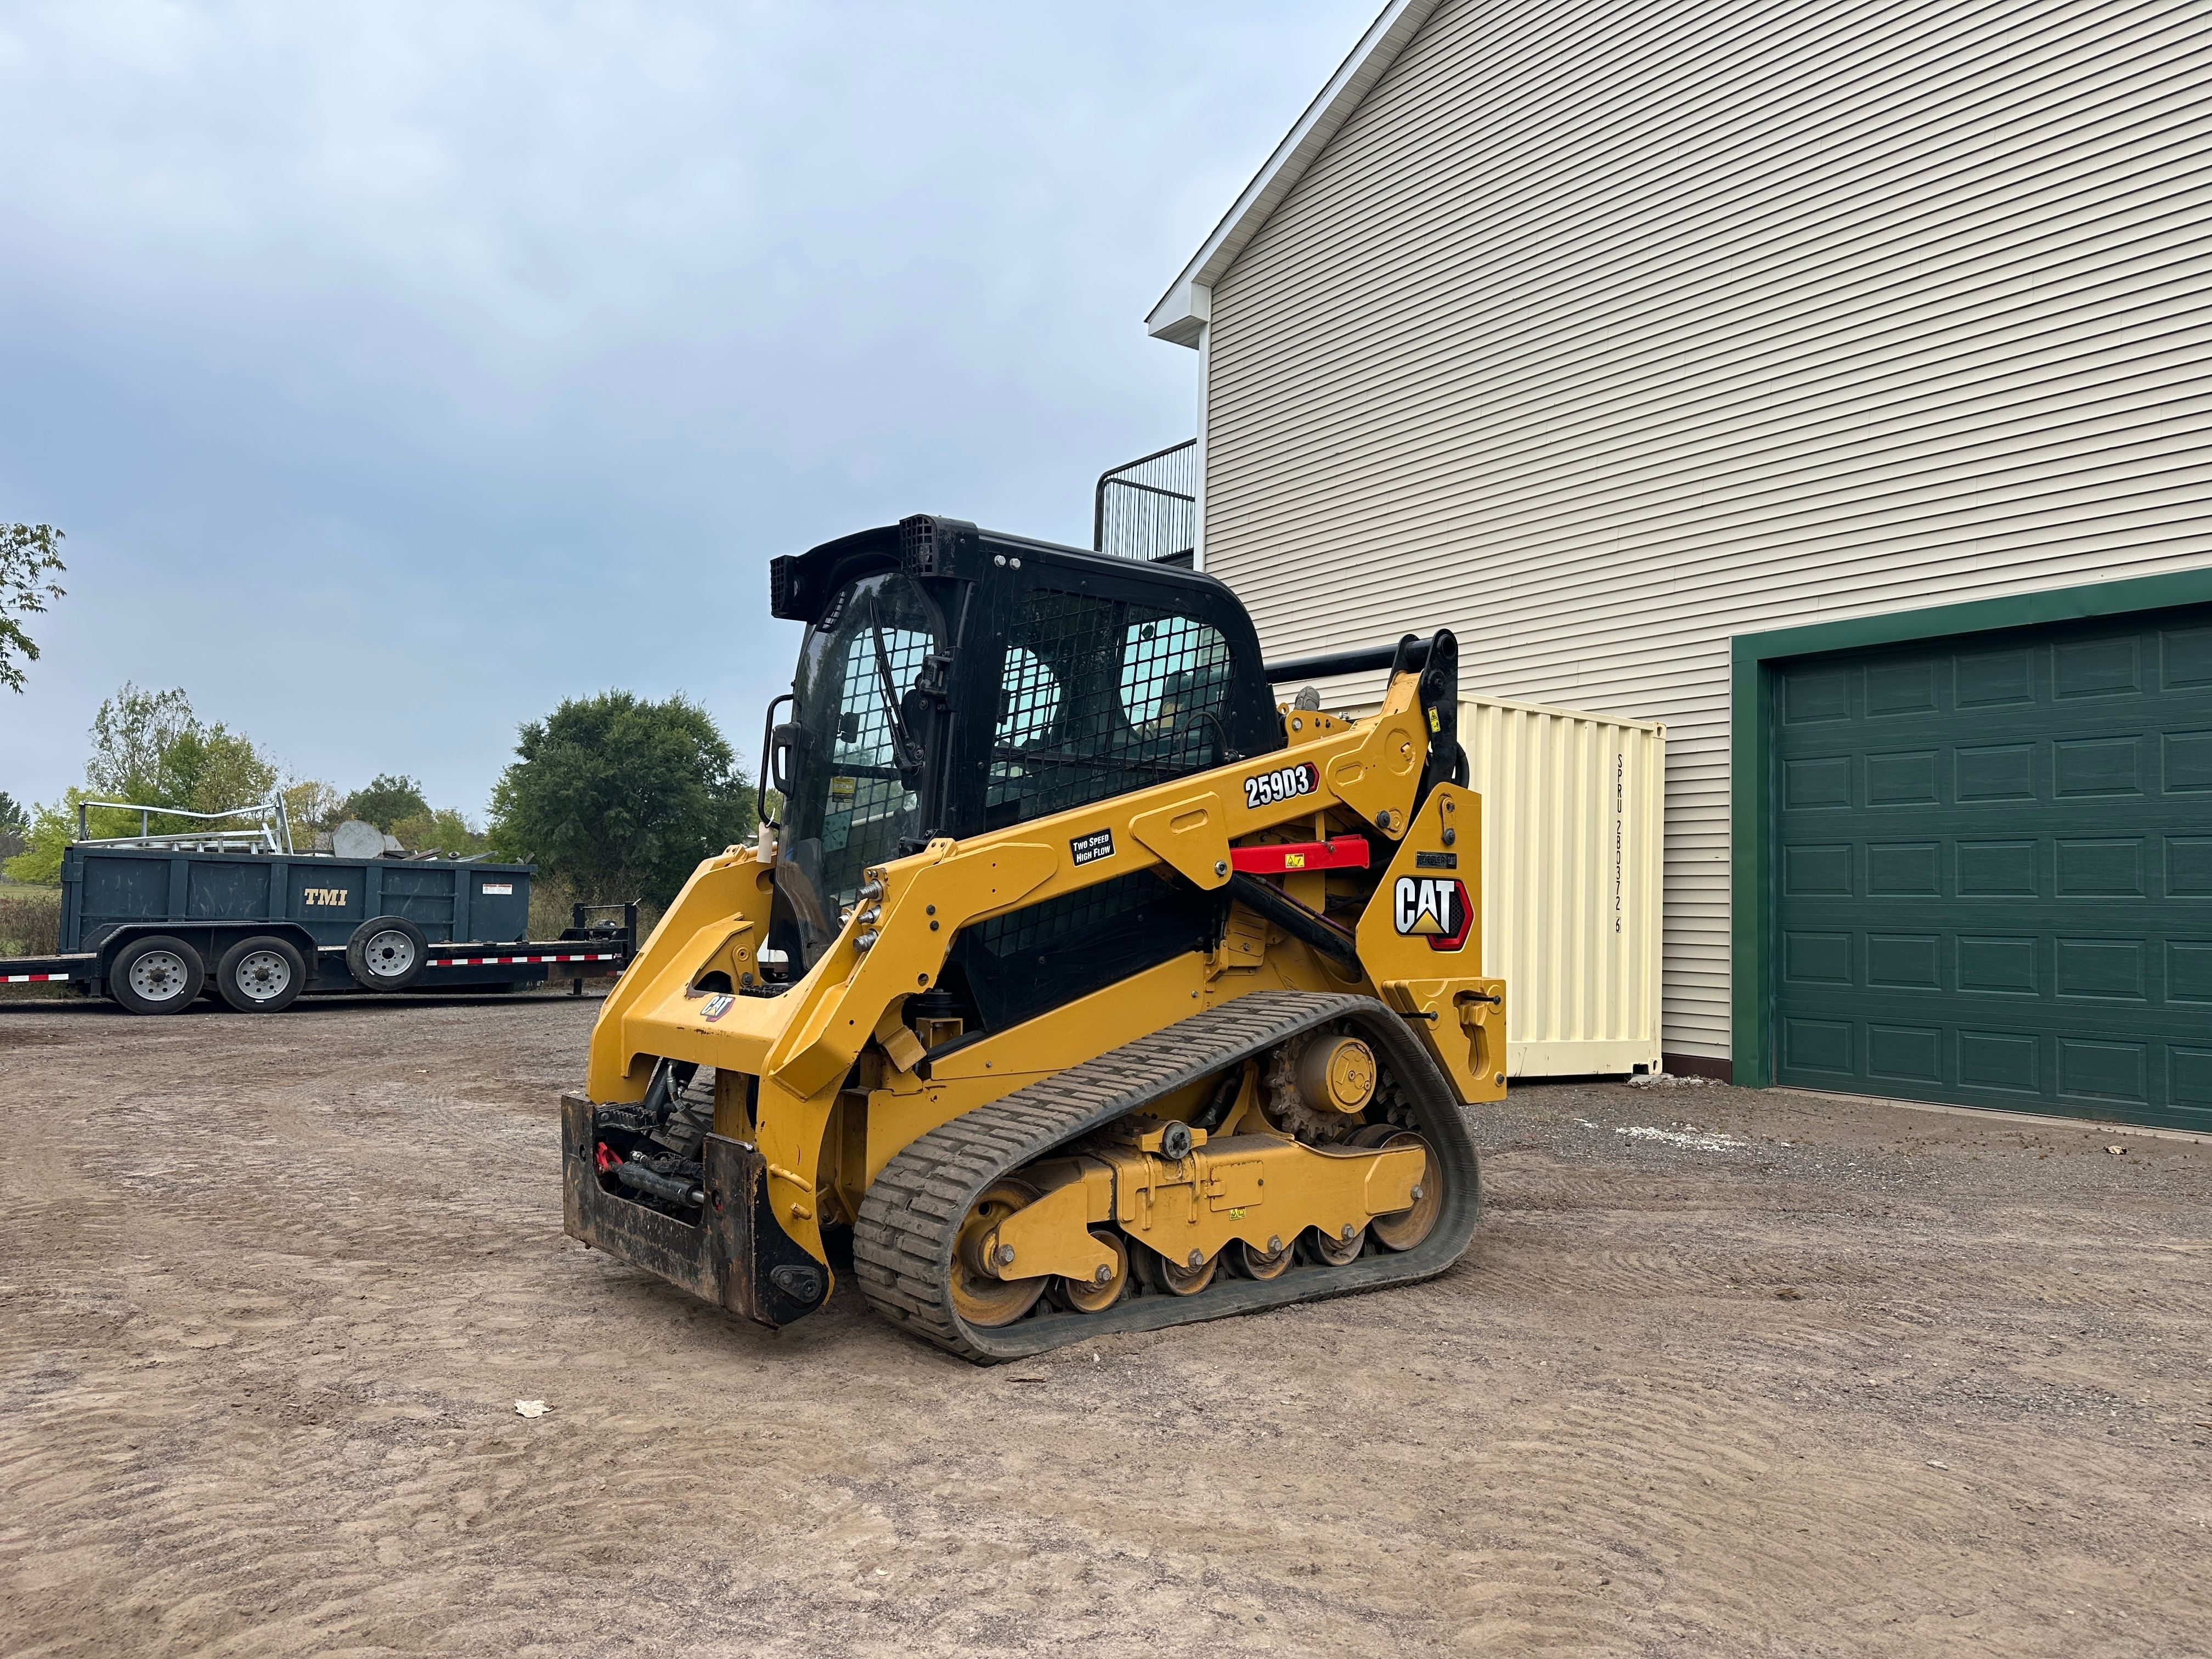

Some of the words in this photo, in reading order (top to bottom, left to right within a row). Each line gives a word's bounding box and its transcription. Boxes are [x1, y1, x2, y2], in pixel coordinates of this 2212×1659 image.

[1245, 766, 1309, 808] 259D3
[304, 888, 348, 906] TMI
[1396, 877, 1455, 934] CAT
[1616, 918, 1620, 932] 6
[701, 995, 733, 1017] CAT
